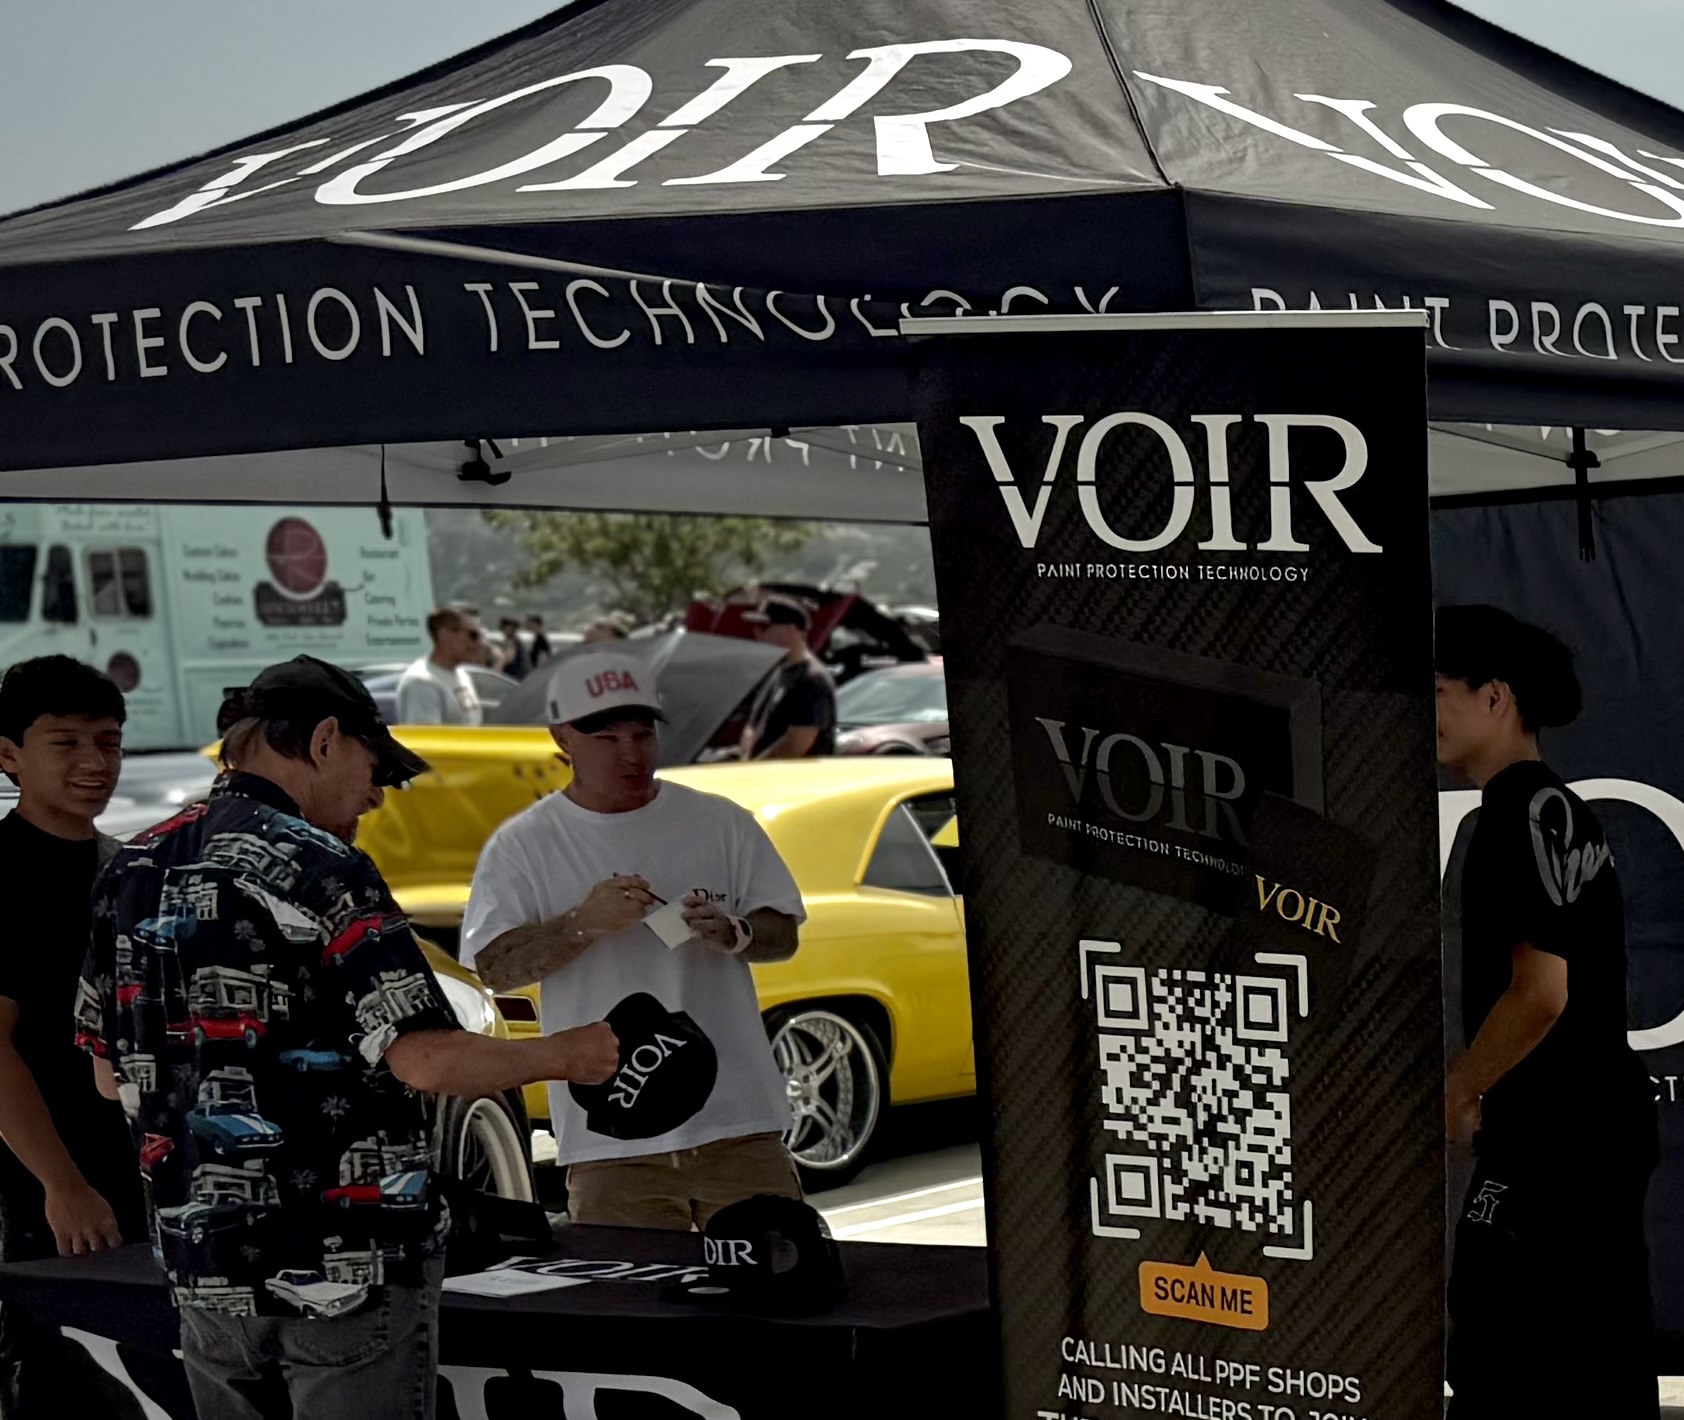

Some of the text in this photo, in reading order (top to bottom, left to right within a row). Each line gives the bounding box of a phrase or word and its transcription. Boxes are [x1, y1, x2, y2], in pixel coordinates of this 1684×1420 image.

[127, 38, 1160, 230] VOIR
[0, 285, 425, 389] ROTECTION
[959, 412, 1383, 553] VOIR
[1037, 563, 1309, 582] PAINT PROTECTION TECHNOLOGY
[585, 670, 639, 698] USA
[1035, 716, 1249, 847] VOIR
[1255, 875, 1341, 944] VOIR
[608, 1033, 687, 1108] VOIR
[704, 1236, 758, 1266] OIR
[1154, 1276, 1253, 1315] SCAN ME
[1058, 1373, 1105, 1403] AND
[1061, 1336, 1361, 1403] CALLING ALL PPF SHOPS
